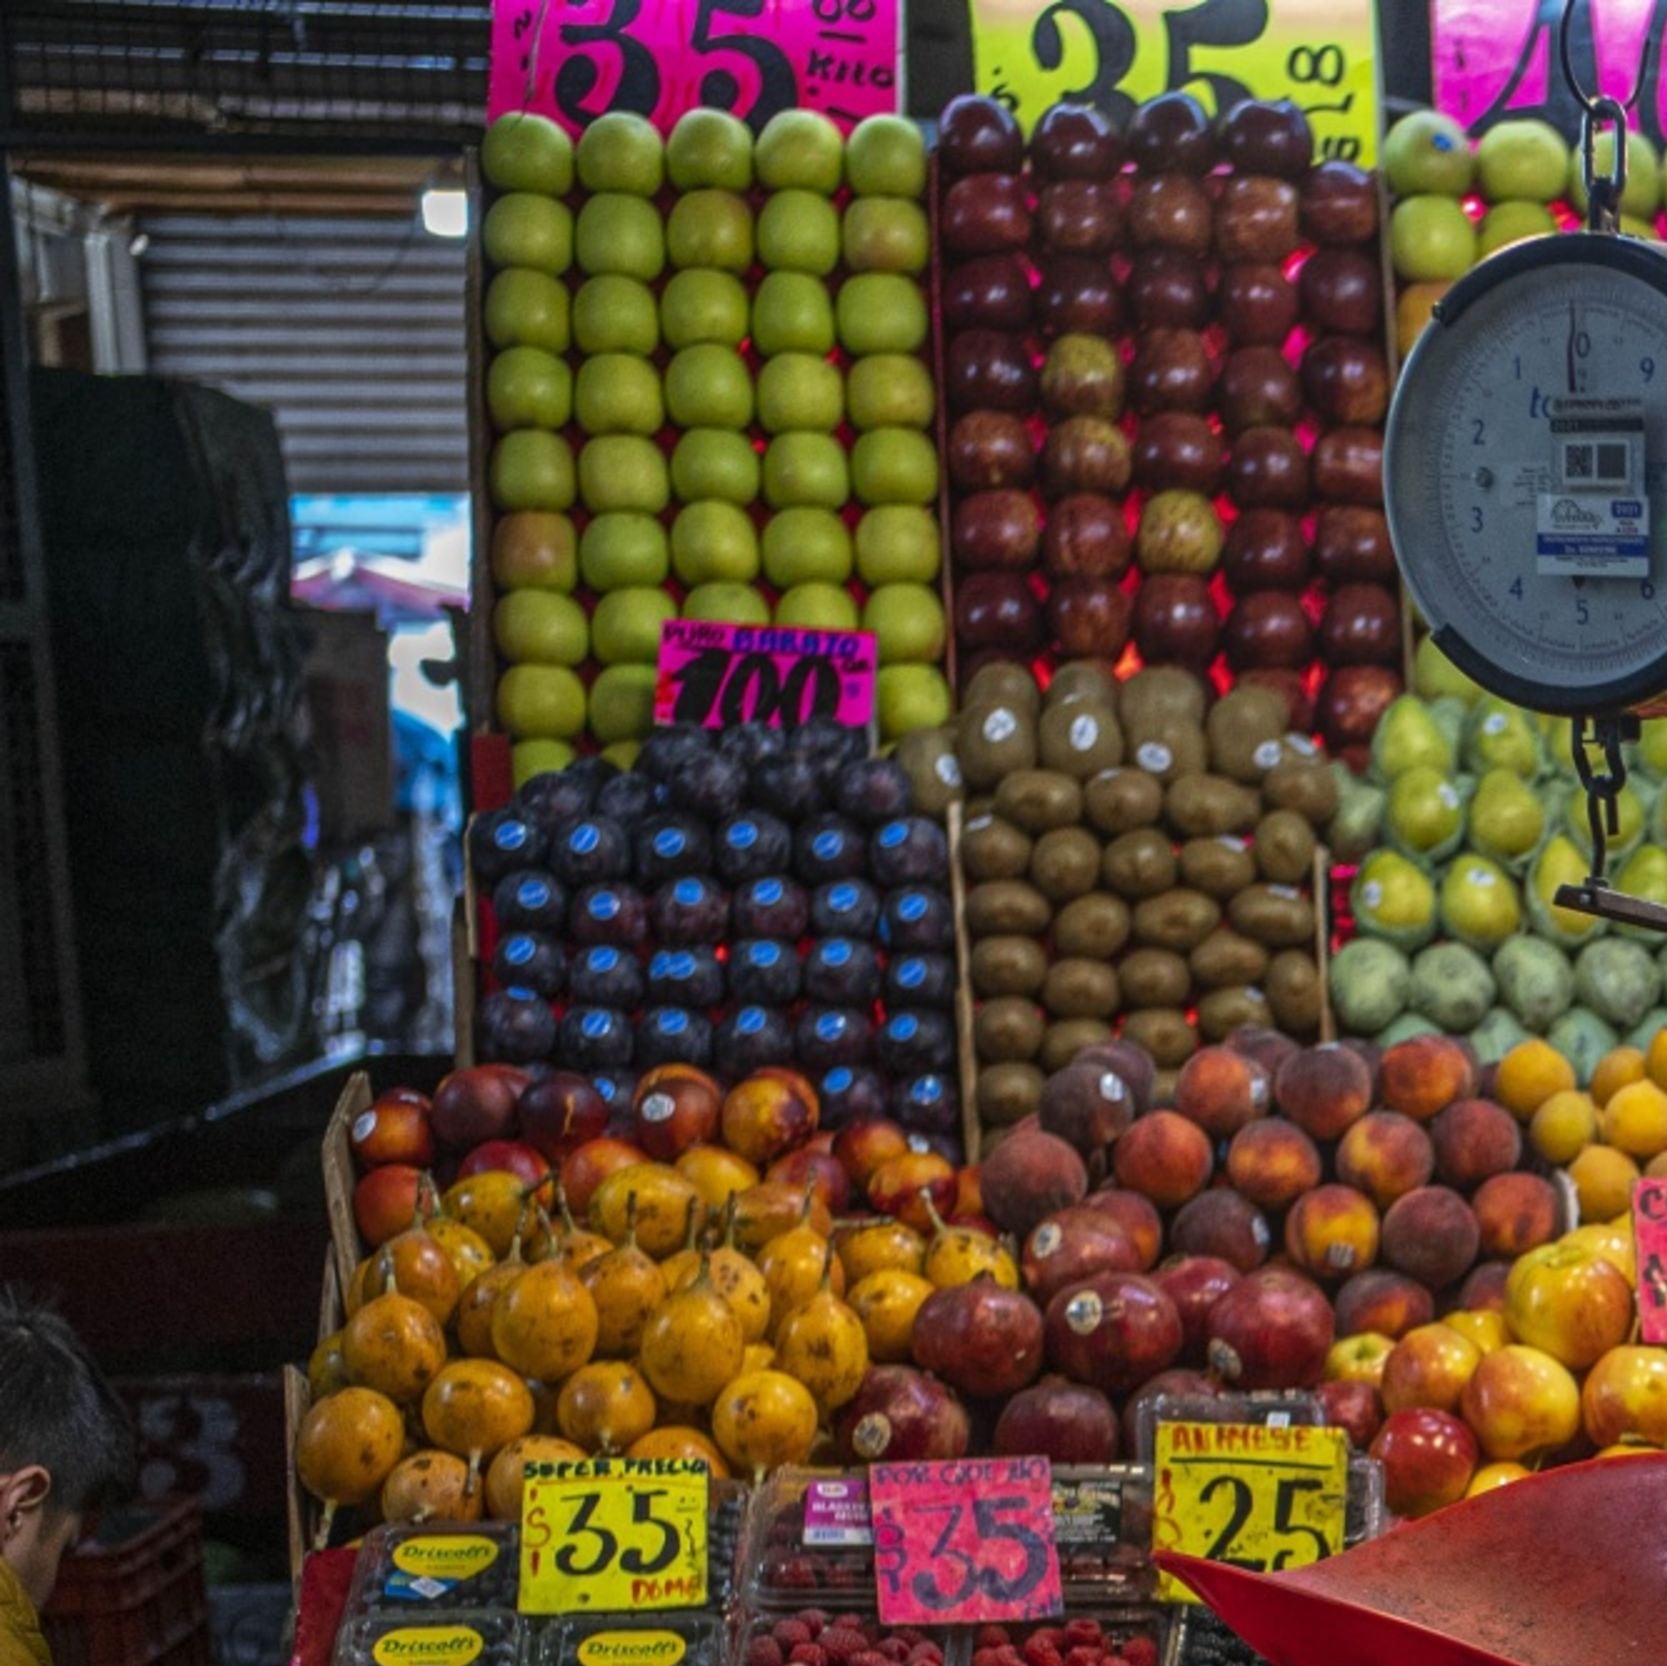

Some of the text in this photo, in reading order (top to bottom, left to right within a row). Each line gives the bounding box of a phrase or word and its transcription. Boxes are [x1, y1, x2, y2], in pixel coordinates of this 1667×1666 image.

[556, 0, 798, 138] 35
[1640, 356, 1656, 383] 9
[1472, 421, 1486, 446] 2
[1470, 506, 1484, 534] 3
[1509, 576, 1524, 601] 4
[1575, 600, 1590, 627] 5
[674, 648, 841, 726] 100
[556, 1486, 681, 1577] 35
[1200, 1475, 1331, 1575] 25
[402, 1545, 492, 1560] Driscoll's
[911, 1497, 1048, 1611] 35
[383, 1636, 477, 1655] Driscoll's
[587, 1638, 679, 1656] Driscoll's
